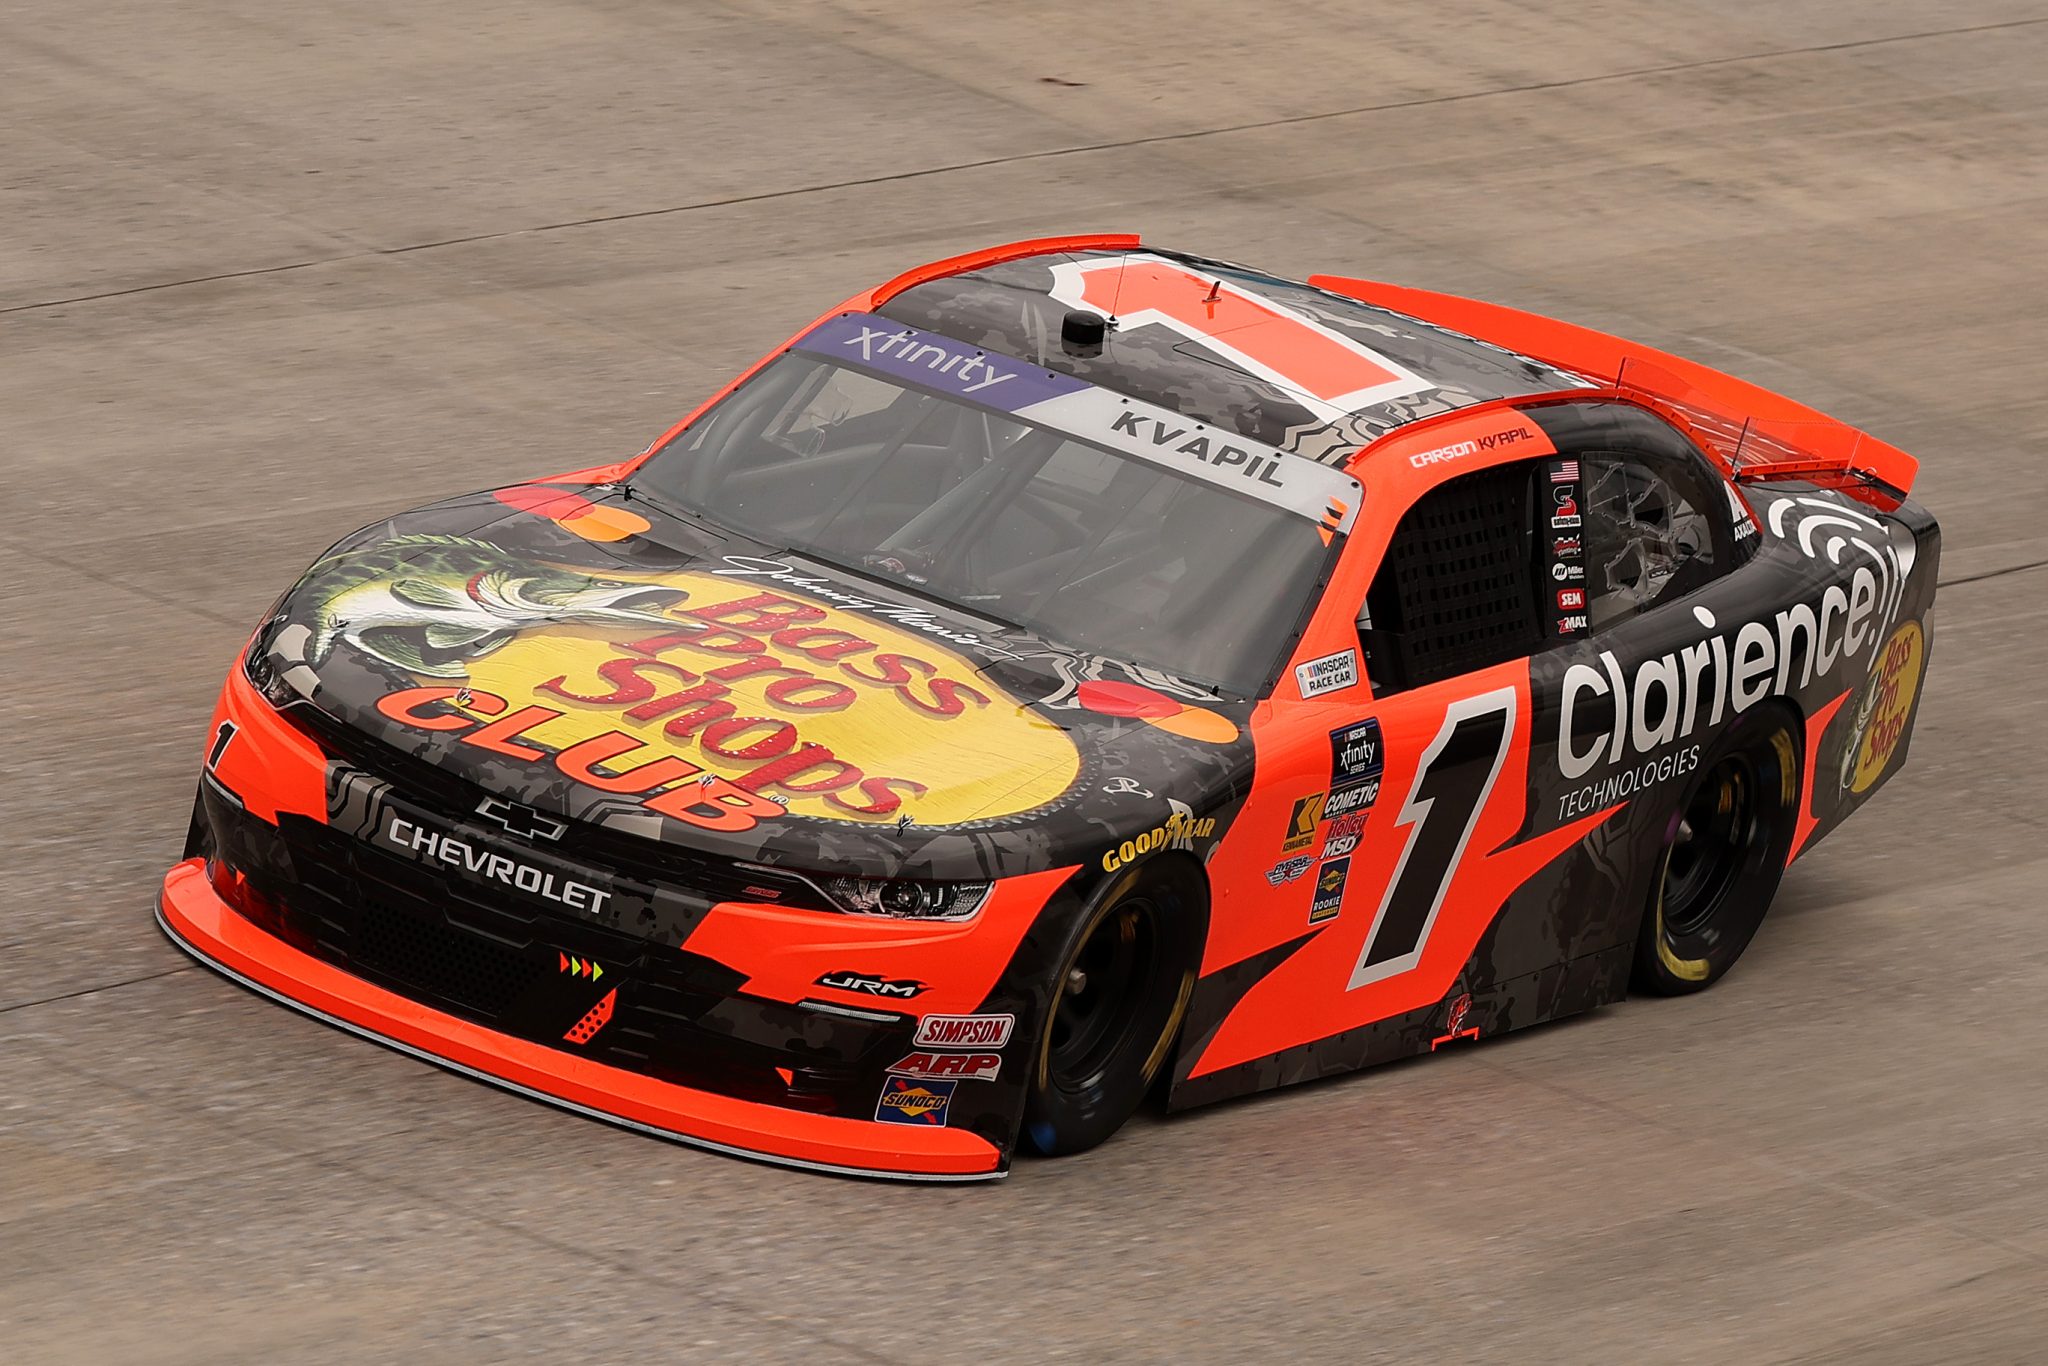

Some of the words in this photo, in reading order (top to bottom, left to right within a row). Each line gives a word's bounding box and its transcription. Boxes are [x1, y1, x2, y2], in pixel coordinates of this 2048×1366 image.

[843, 325, 1017, 392] xfinity
[1109, 409, 1285, 488] KVAPIL
[1408, 440, 1477, 469] CARSON
[1477, 427, 1535, 451] KVAPIL
[1561, 592, 1582, 606] SEM
[618, 619, 858, 713] Pro
[667, 589, 991, 720] Bass
[1309, 676, 1333, 691] RACE
[1334, 670, 1351, 684] CAR
[1315, 655, 1350, 676] NASCAR
[1880, 631, 1915, 684] Bass
[206, 719, 240, 773] 1
[374, 684, 789, 833] CLUB
[530, 655, 932, 819] Shops
[1340, 740, 1375, 771] xfinity
[1863, 706, 1906, 771] Shops
[1324, 782, 1379, 815] COMETIC
[1557, 745, 1700, 821] TECHNOLOGIES
[1102, 814, 1216, 873] GOODYEAR
[1320, 835, 1357, 860] MSD
[1345, 685, 1517, 993] 1
[388, 817, 612, 915] CHEVROLET
[1313, 895, 1341, 911] ROOKIE
[822, 976, 916, 997] JRM
[922, 1019, 1007, 1043] SIMPSON
[890, 1052, 1000, 1076] ARP
[884, 1093, 947, 1109] SUNOCO
